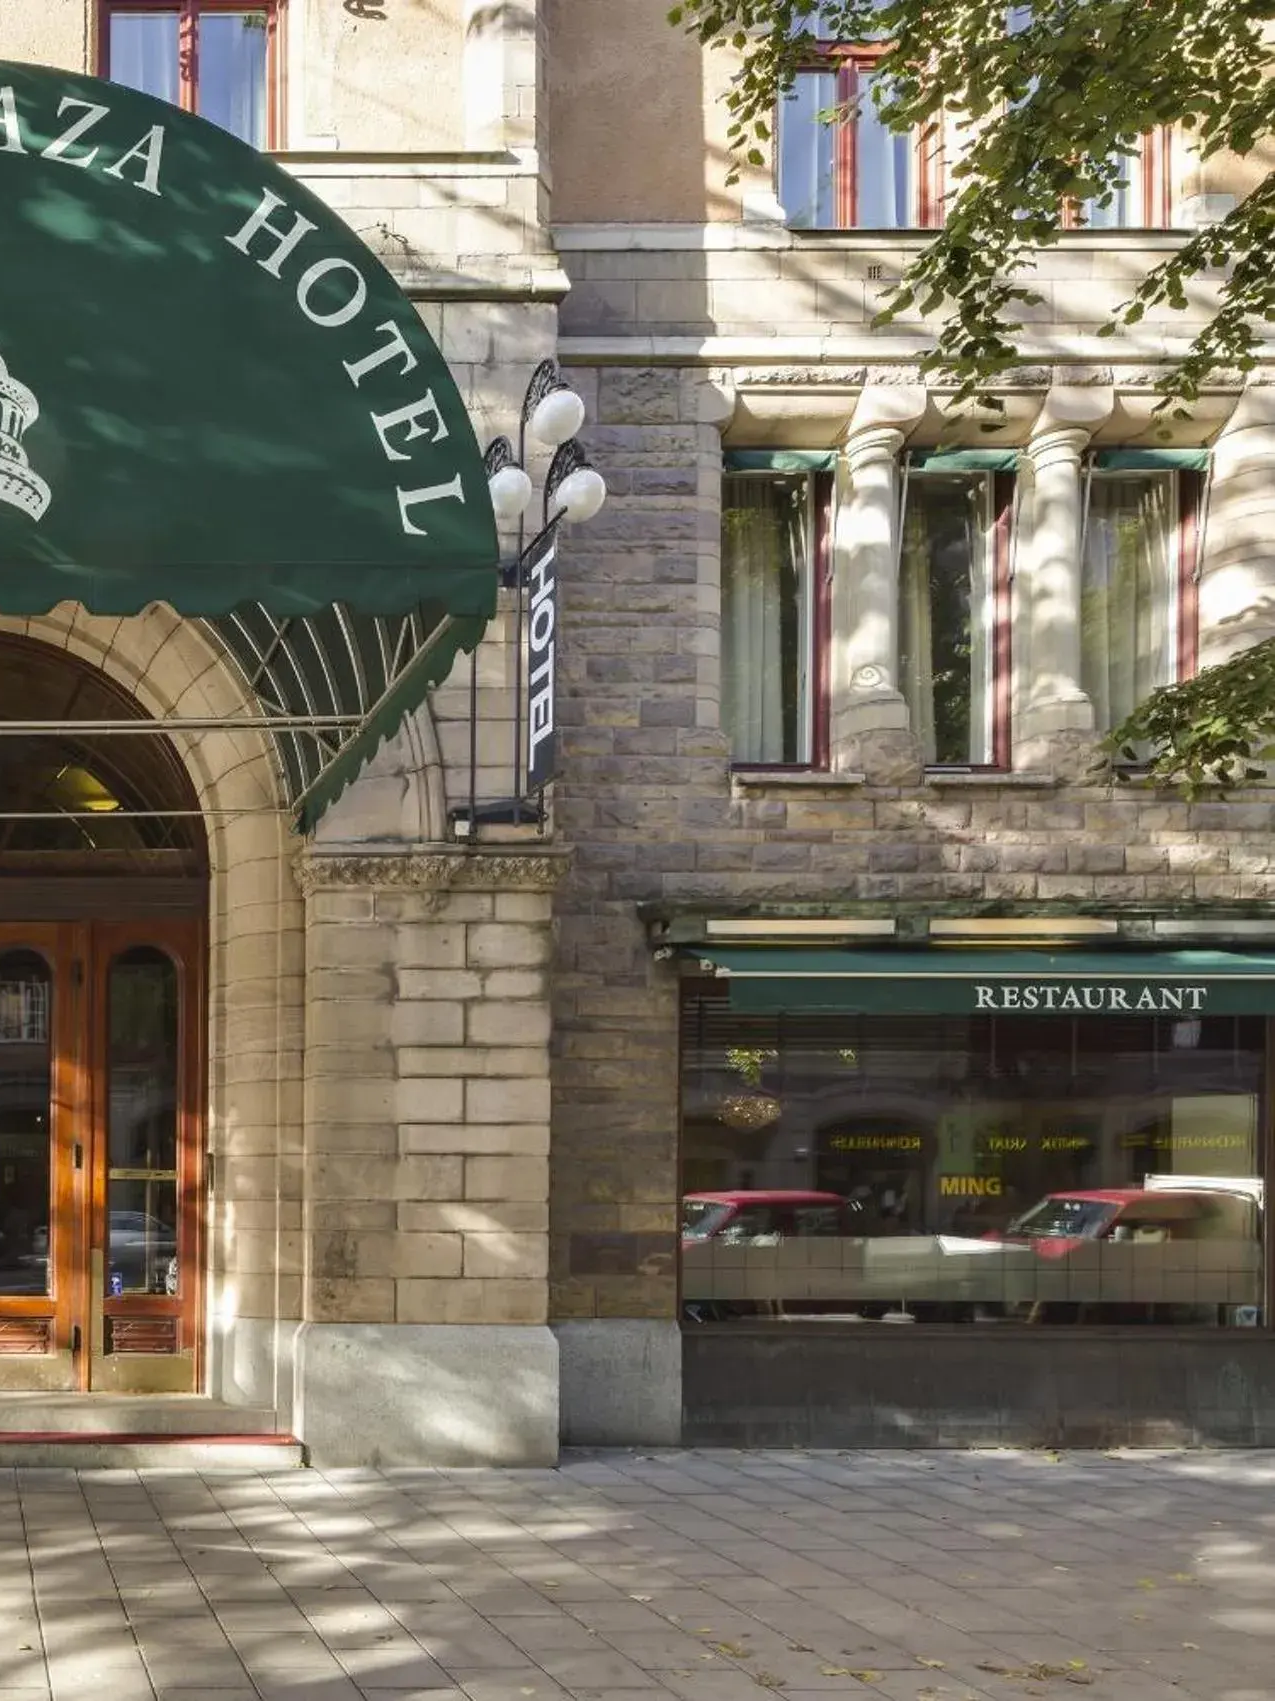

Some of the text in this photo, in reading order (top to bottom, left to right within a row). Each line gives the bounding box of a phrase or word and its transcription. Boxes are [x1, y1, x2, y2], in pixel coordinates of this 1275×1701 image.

[224, 185, 466, 537] HOTEL
[528, 546, 555, 772] HOTEL
[974, 985, 1208, 1010] RESTAURANT
[940, 1176, 1002, 1196] MING
